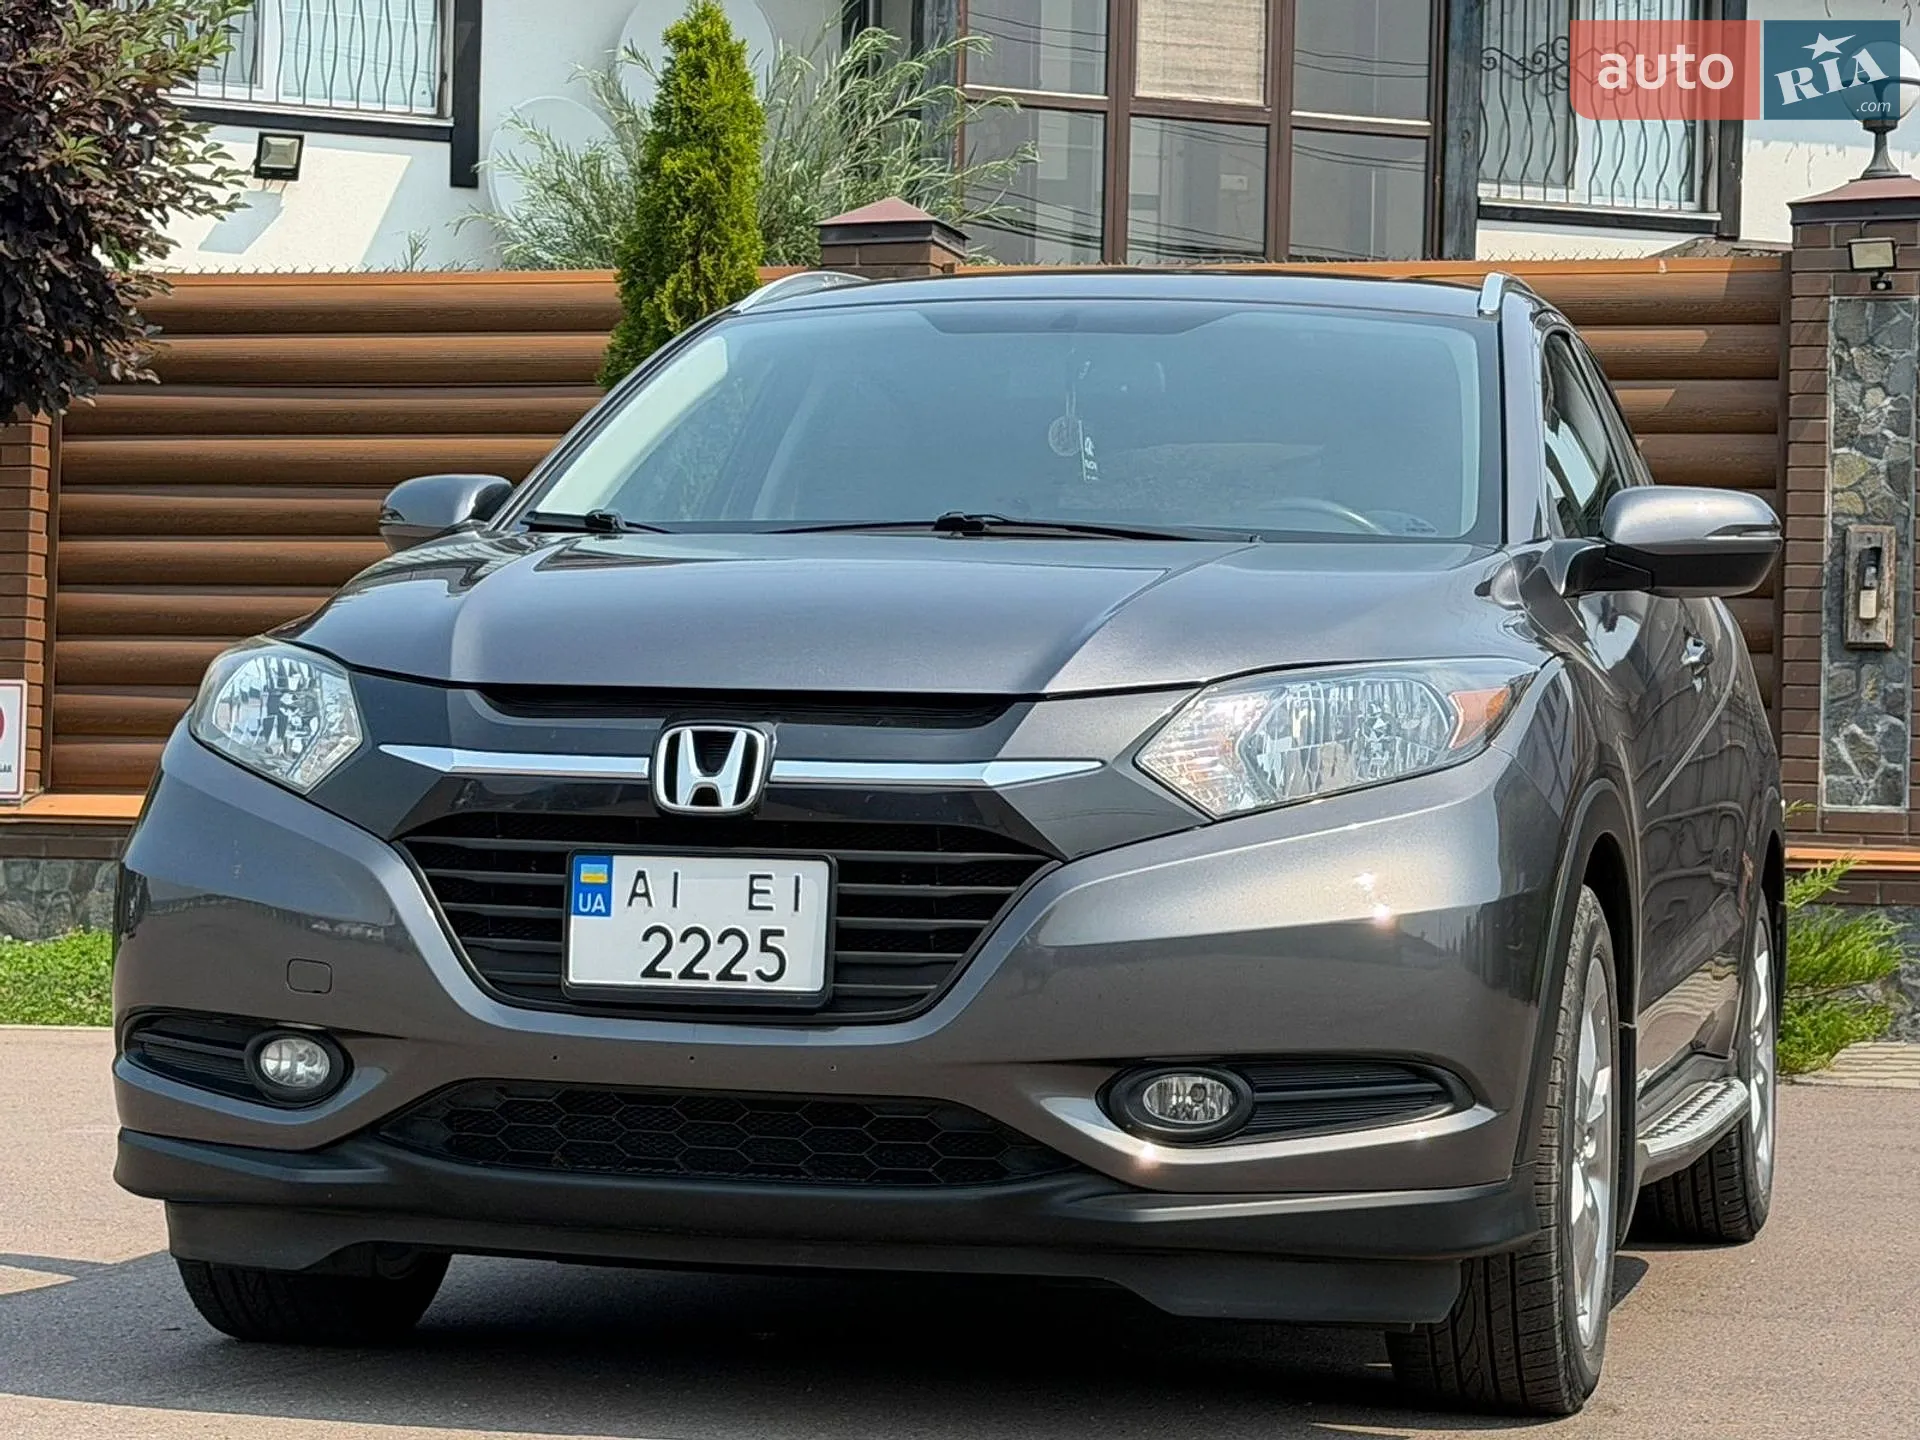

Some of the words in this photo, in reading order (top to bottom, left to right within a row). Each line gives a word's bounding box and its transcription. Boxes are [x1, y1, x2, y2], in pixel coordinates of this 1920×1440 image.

[578, 893, 606, 913] UA
[627, 870, 680, 908] AI
[748, 874, 801, 912] EI
[640, 925, 787, 982] 2225
